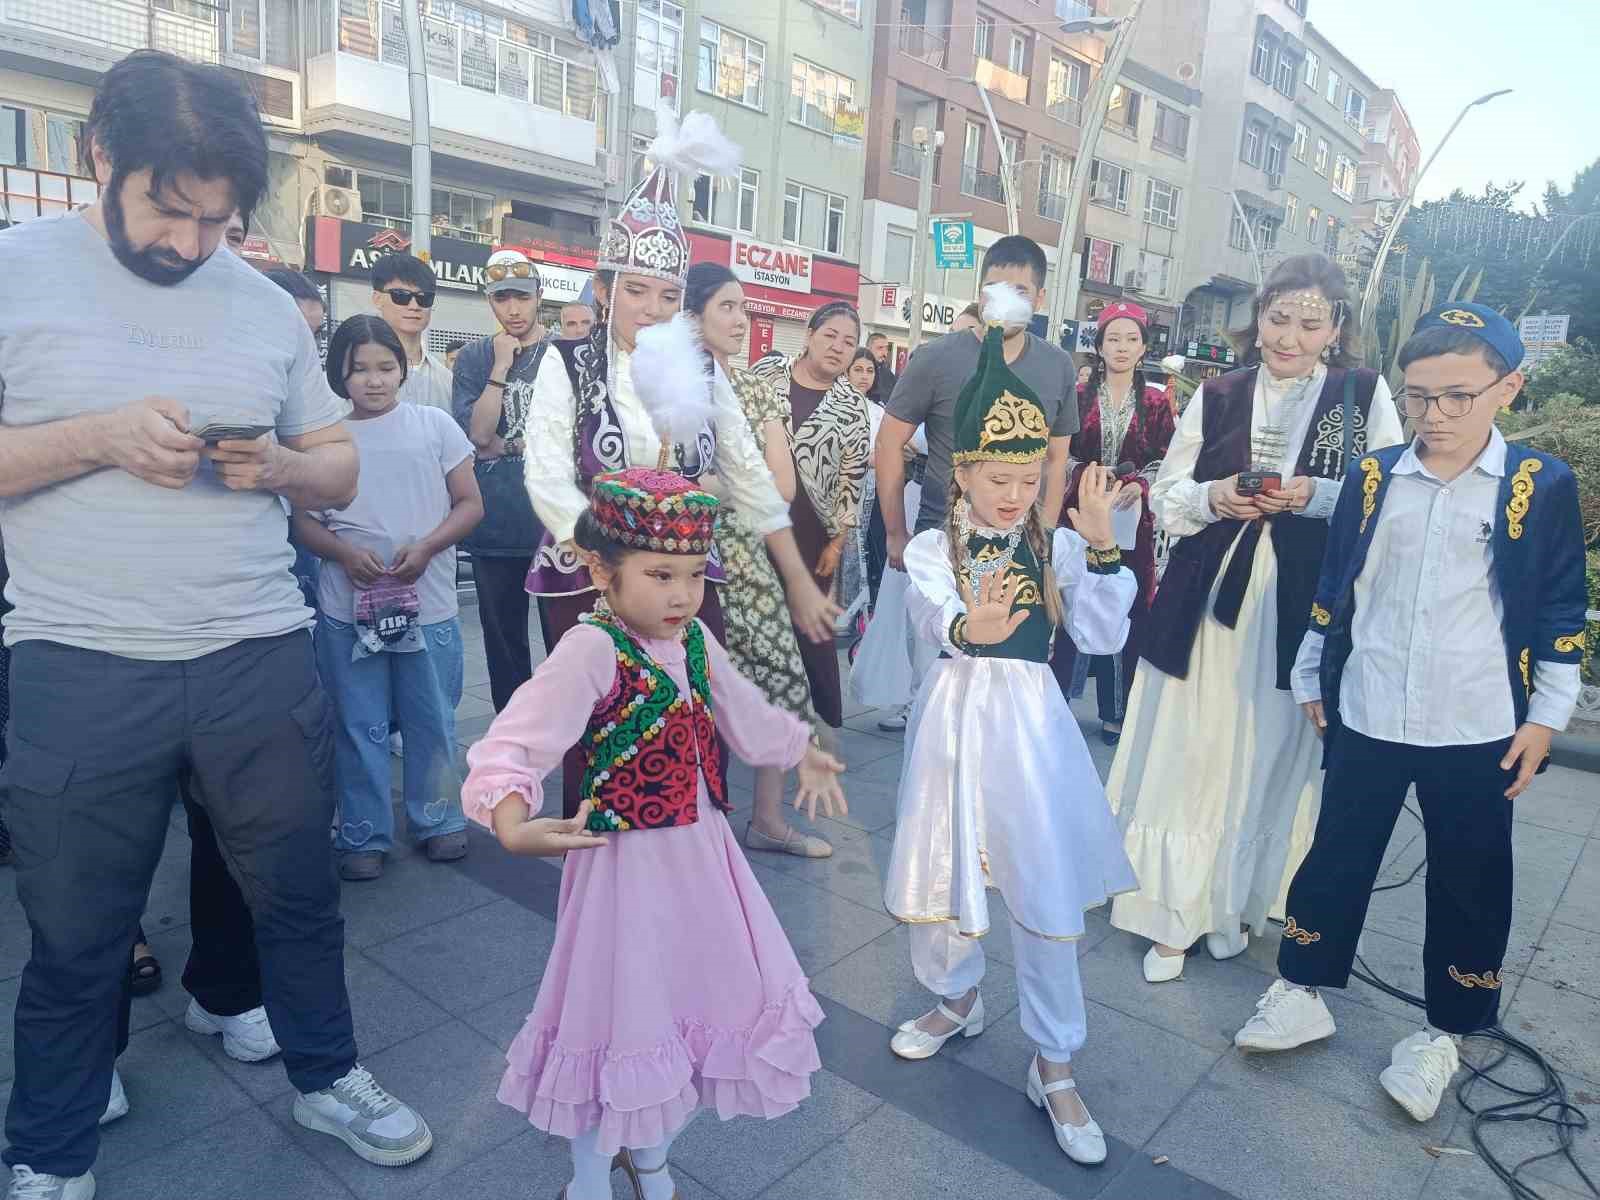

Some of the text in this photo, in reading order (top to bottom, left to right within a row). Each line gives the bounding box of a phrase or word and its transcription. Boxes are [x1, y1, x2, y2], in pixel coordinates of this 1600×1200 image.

[736, 239, 808, 277] ECZANE
[428, 260, 486, 285] MLAK
[541, 274, 579, 292] İKCELL
[884, 290, 894, 303] E
[922, 302, 954, 325] QNB
